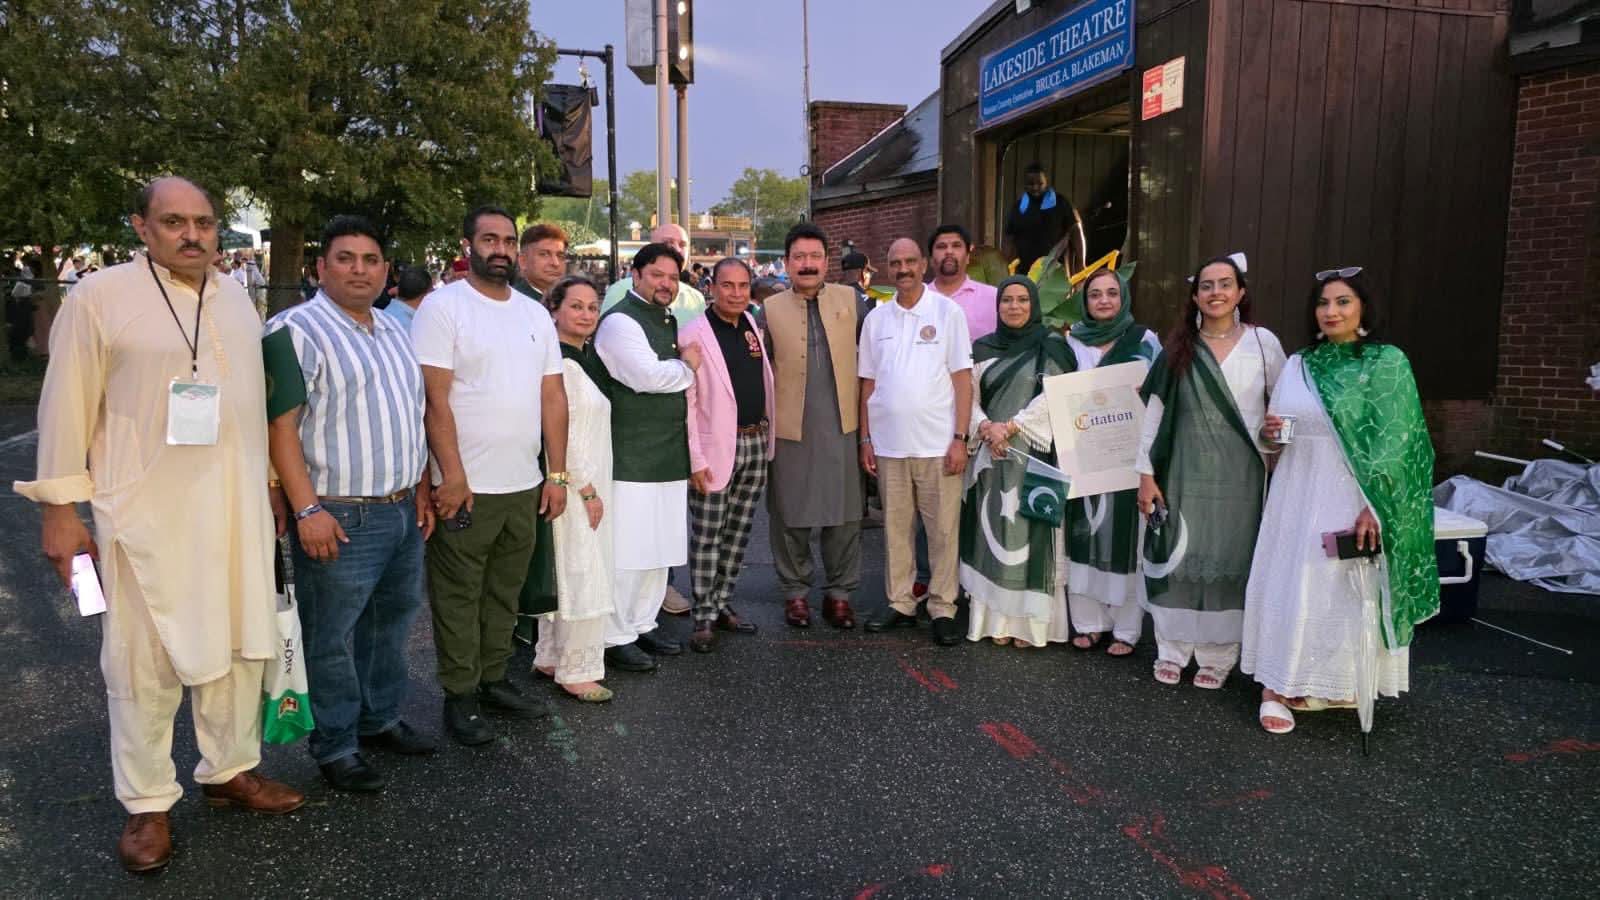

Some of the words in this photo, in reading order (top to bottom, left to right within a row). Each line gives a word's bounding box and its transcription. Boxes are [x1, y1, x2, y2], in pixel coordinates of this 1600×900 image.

[983, 40, 1047, 92] LAKESIDE
[1049, 0, 1126, 60] THEATRE
[1035, 70, 1061, 94] BRUCE
[1071, 41, 1124, 77] BLAKEMAN
[1075, 410, 1133, 431] Citation
